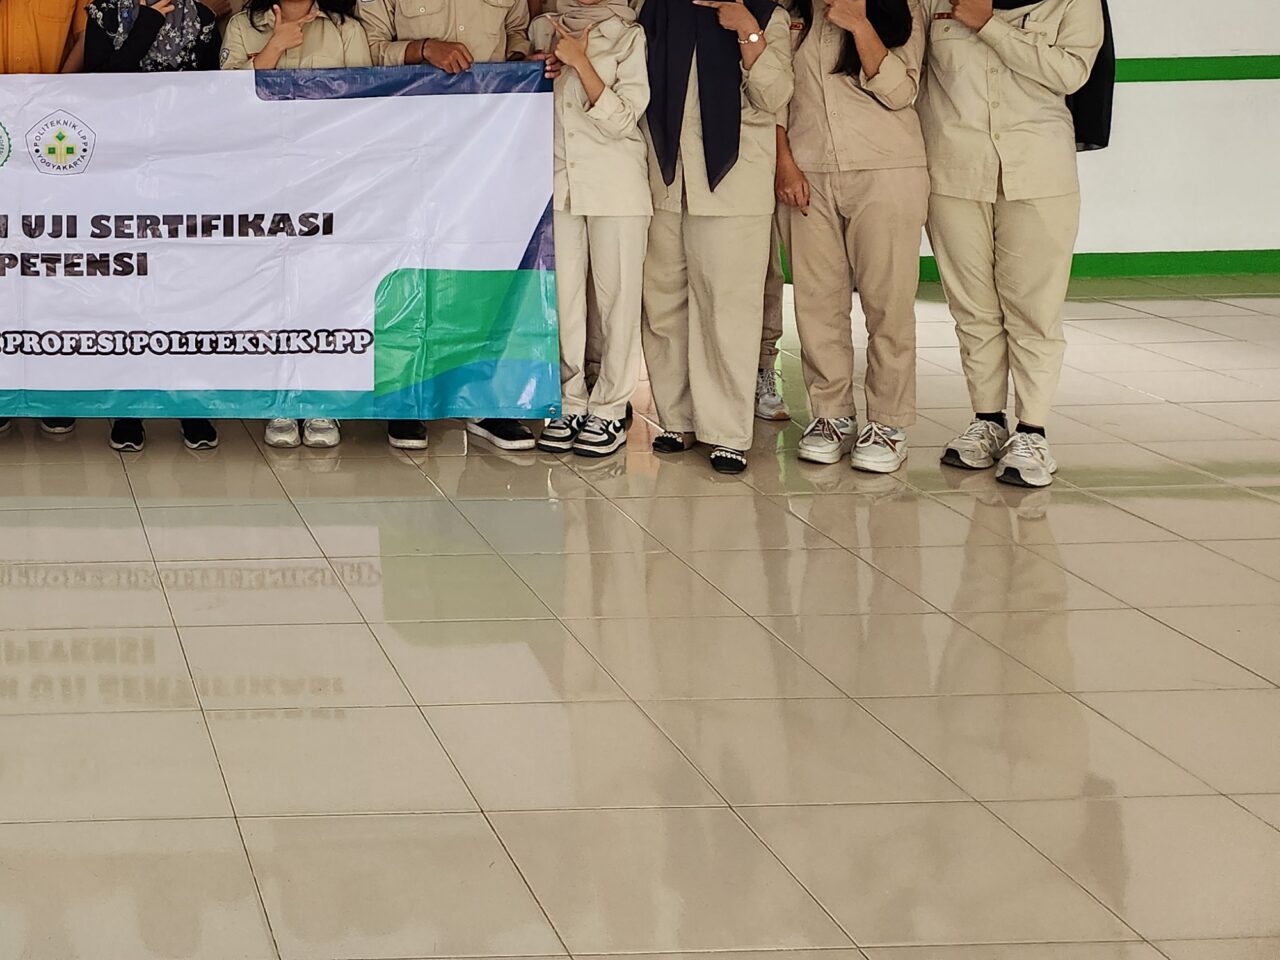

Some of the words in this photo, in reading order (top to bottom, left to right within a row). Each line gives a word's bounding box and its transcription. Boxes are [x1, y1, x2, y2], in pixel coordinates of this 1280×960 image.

[33, 119, 78, 147] POLITEKNIK
[77, 129, 89, 147] LPP
[36, 153, 87, 171] YOGYAKARTA
[22, 214, 78, 239] UJI
[90, 212, 334, 239] SERTIFIKASI
[2, 330, 130, 356] PROFESI
[129, 329, 314, 355] POLITEKNIK
[314, 328, 375, 354] LPP
